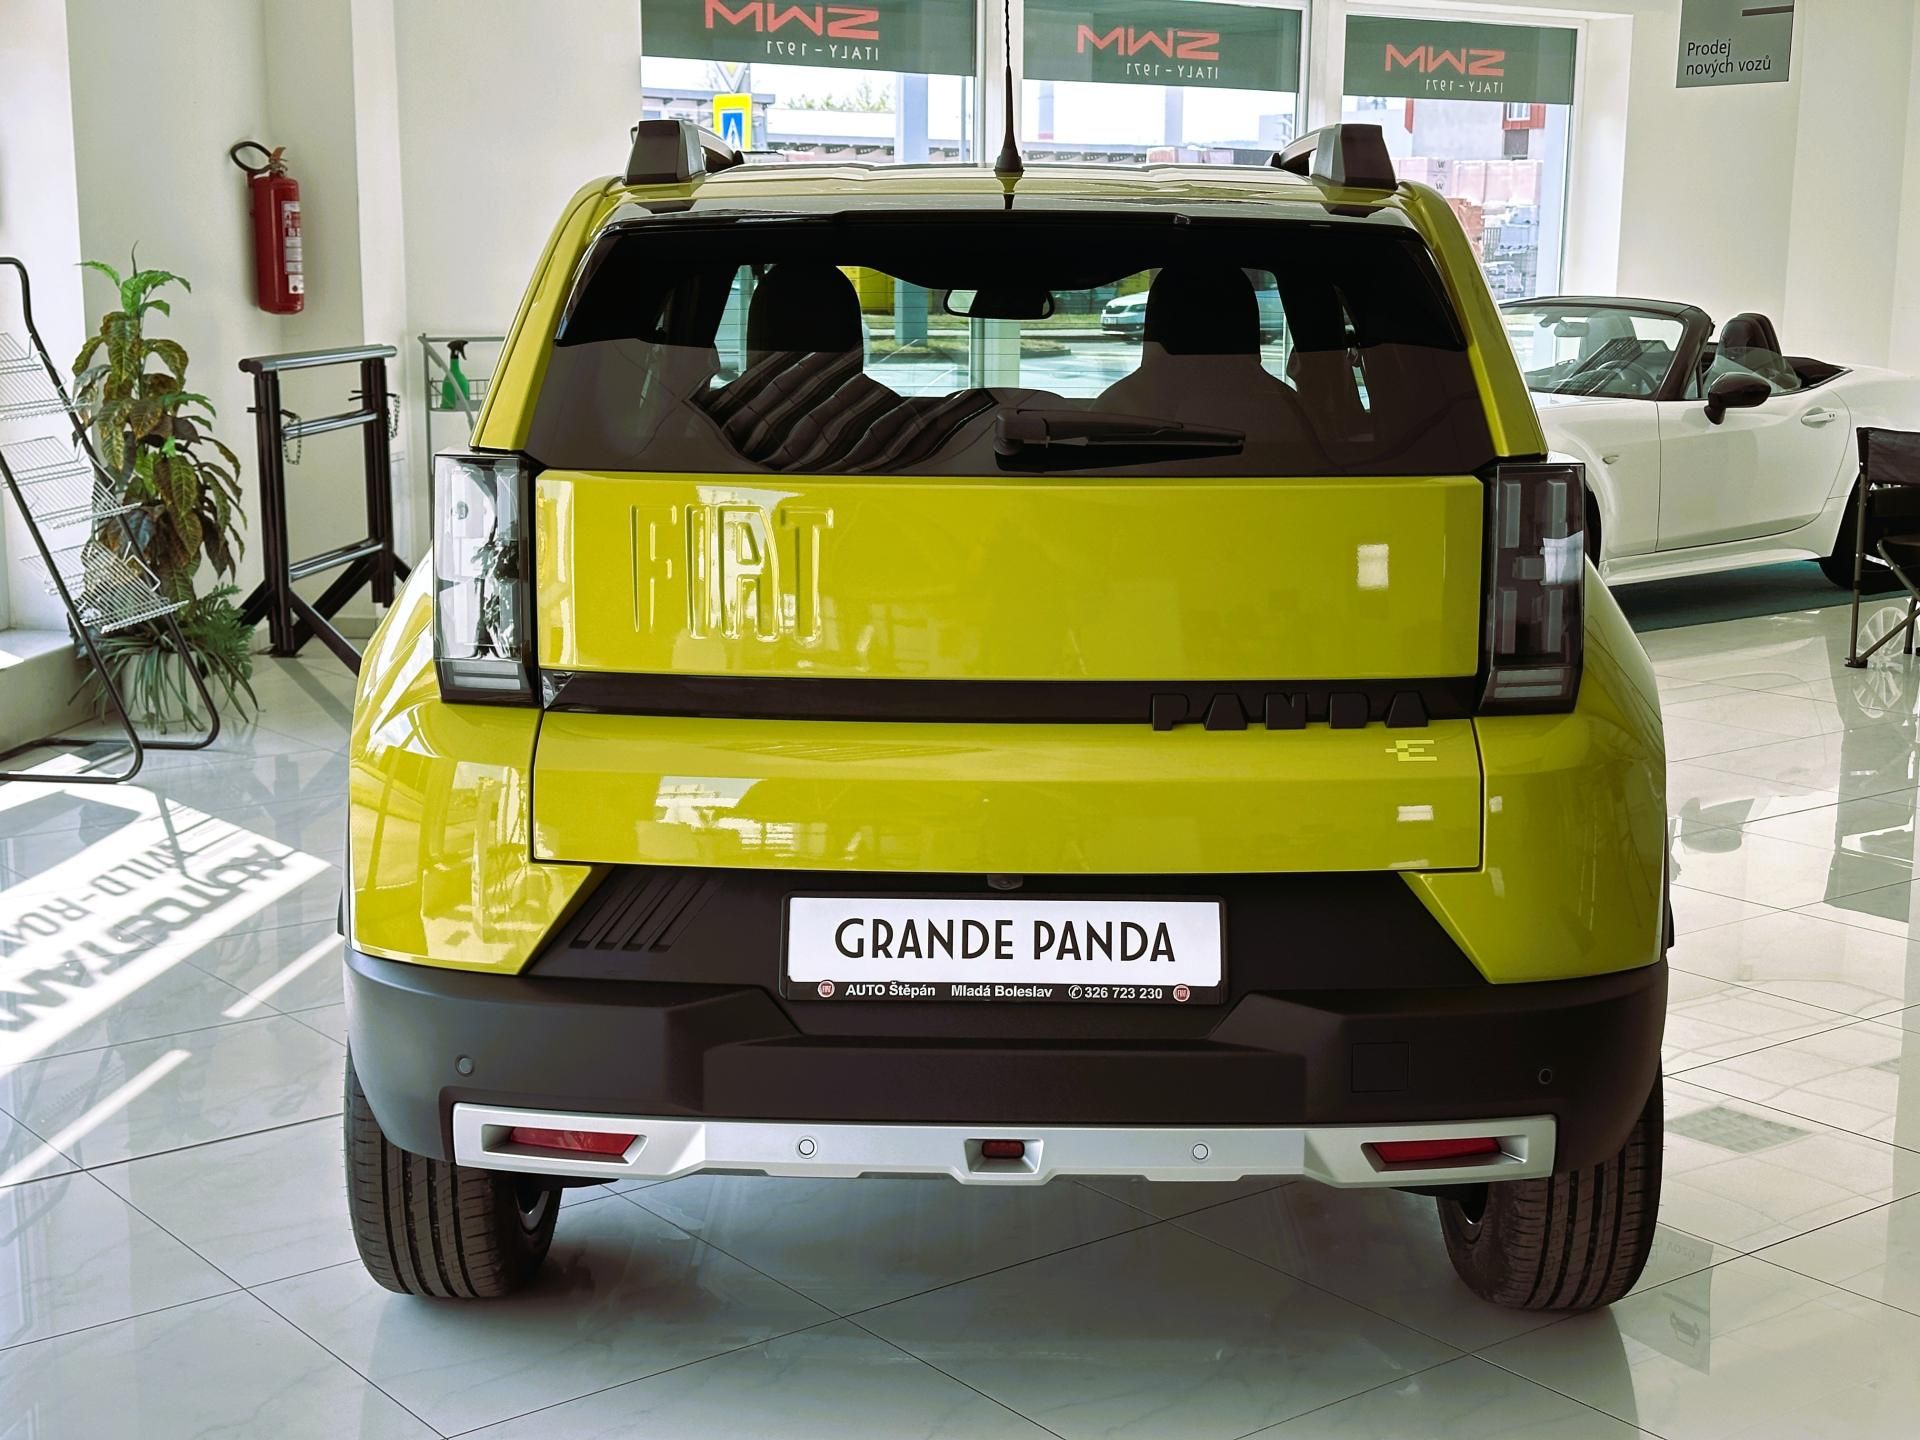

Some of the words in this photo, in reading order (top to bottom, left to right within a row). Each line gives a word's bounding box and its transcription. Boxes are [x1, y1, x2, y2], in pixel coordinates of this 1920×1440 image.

[1687, 38, 1731, 58] Prodej
[1686, 58, 1734, 78] nových
[1738, 54, 1771, 72] vozů
[629, 503, 834, 648] FIAT
[1152, 691, 1429, 731] PANDA
[834, 917, 1014, 961] GRANDE
[1033, 920, 1176, 963] PANDA
[845, 984, 886, 996] AUTO
[888, 981, 936, 999] Štěpán
[951, 984, 991, 997] Mladá
[994, 984, 1053, 998] Boleslav
[1084, 986, 1109, 999] 326
[1112, 987, 1136, 1000] 723
[1139, 987, 1163, 1000] 230
